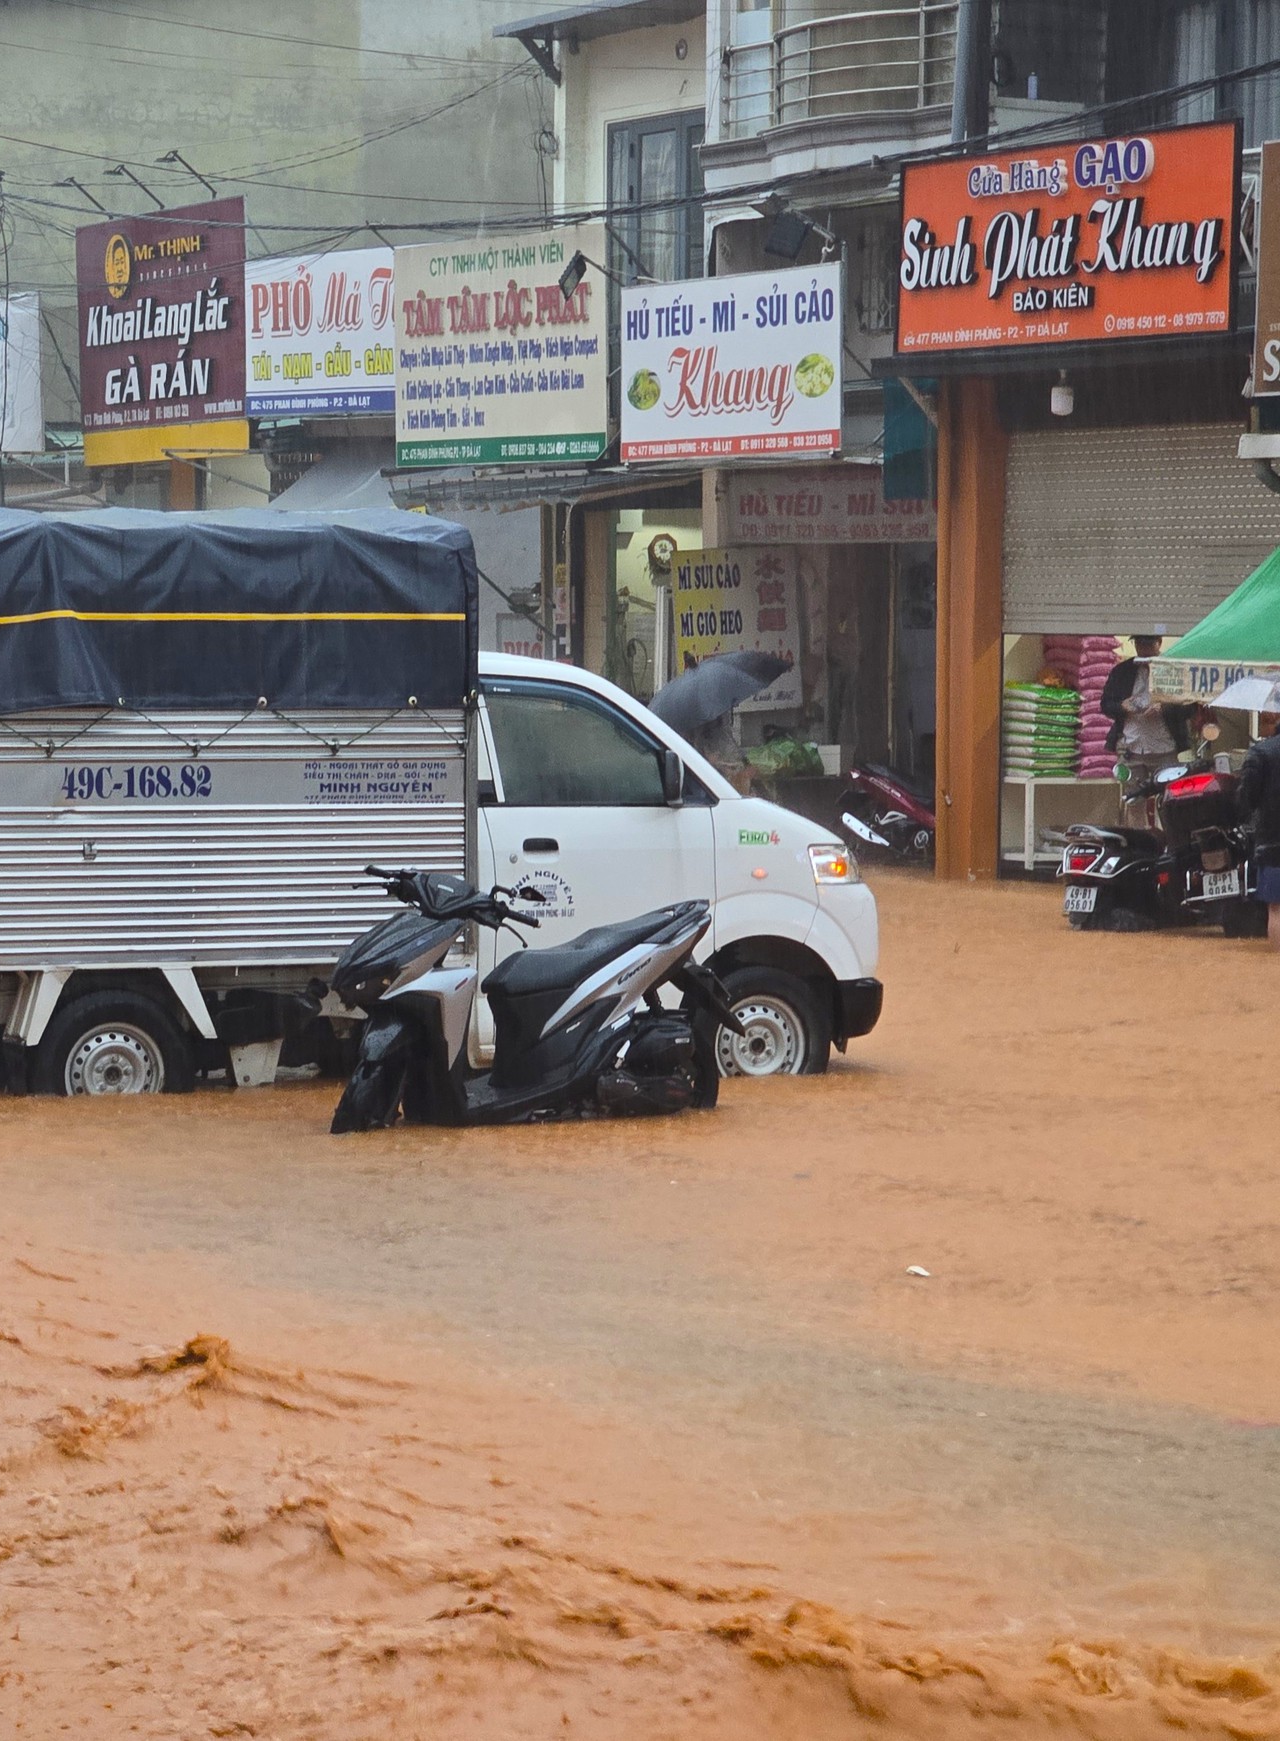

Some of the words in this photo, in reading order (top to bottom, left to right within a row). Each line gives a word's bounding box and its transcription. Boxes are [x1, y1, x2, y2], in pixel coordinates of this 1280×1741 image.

[969, 165, 1005, 197] Cửa
[1009, 160, 1066, 196] Hàng
[1074, 139, 1151, 194] GẠO
[134, 244, 155, 262] Mr.
[158, 235, 200, 261] THỊNH
[430, 257, 447, 276] CTY
[452, 254, 476, 273] TNHH
[478, 248, 499, 275] MỘT
[502, 242, 536, 268] THÀNH
[539, 240, 564, 263] VIÊN
[900, 216, 973, 291] Sinh
[984, 211, 1076, 298] Phát
[1082, 198, 1219, 283] Khang
[251, 264, 312, 338] PHỞ
[318, 271, 363, 333] Má
[403, 289, 444, 337] TÂM
[447, 285, 490, 335] TÂM
[494, 279, 532, 336] LỘC
[627, 298, 649, 341] HỦ
[656, 295, 693, 338] TIẾU
[713, 293, 735, 333] MÌ
[756, 283, 788, 328] SỦI
[795, 279, 834, 324] CẢO
[1013, 286, 1045, 312] BẢO
[1053, 283, 1089, 308] KIÊN
[916, 333, 929, 345] 477
[931, 332, 953, 344] PHAN
[955, 328, 972, 343] ĐÌNH
[974, 326, 1001, 341] PHÙNG
[1008, 327, 1018, 339] P2
[1025, 325, 1036, 336] TP
[1038, 322, 1050, 336] ĐÀ
[1052, 322, 1068, 337] LẠT
[1137, 315, 1151, 328] 450
[1154, 314, 1166, 327] 112
[1173, 314, 1183, 326] 08
[1185, 312, 1203, 325] 1979
[1205, 311, 1225, 324] 7879
[575, 333, 598, 360] Compact
[105, 355, 141, 405] GÀ
[149, 349, 210, 400] RÁN
[252, 351, 271, 380] TÁI
[283, 352, 313, 384] NẠM
[365, 343, 394, 375] GÂN
[474, 376, 483, 395] Lan
[484, 375, 494, 395] Can
[571, 369, 584, 389] Loan
[666, 345, 793, 424] Khang
[274, 399, 290, 410] PHAN
[308, 395, 328, 408] PHÙNG
[358, 395, 370, 408] LẠT
[638, 445, 648, 456] 477
[649, 444, 663, 456] PHAN
[678, 440, 697, 454] PHÙNG
[701, 442, 709, 453] P2
[713, 439, 721, 452] ĐÀ
[722, 440, 732, 454] LẠT
[750, 438, 764, 450] 0911
[678, 559, 692, 590] MÌ
[694, 554, 714, 589] SỦI
[716, 552, 742, 588] CẢO
[681, 605, 694, 637] MÌ
[696, 604, 717, 636] GIÒ
[720, 610, 743, 635] HEO
[1189, 665, 1219, 697] TẠP
[61, 764, 212, 800] 49C-168.82
[320, 783, 361, 793] MINH
[367, 780, 432, 793] NGUYÊN
